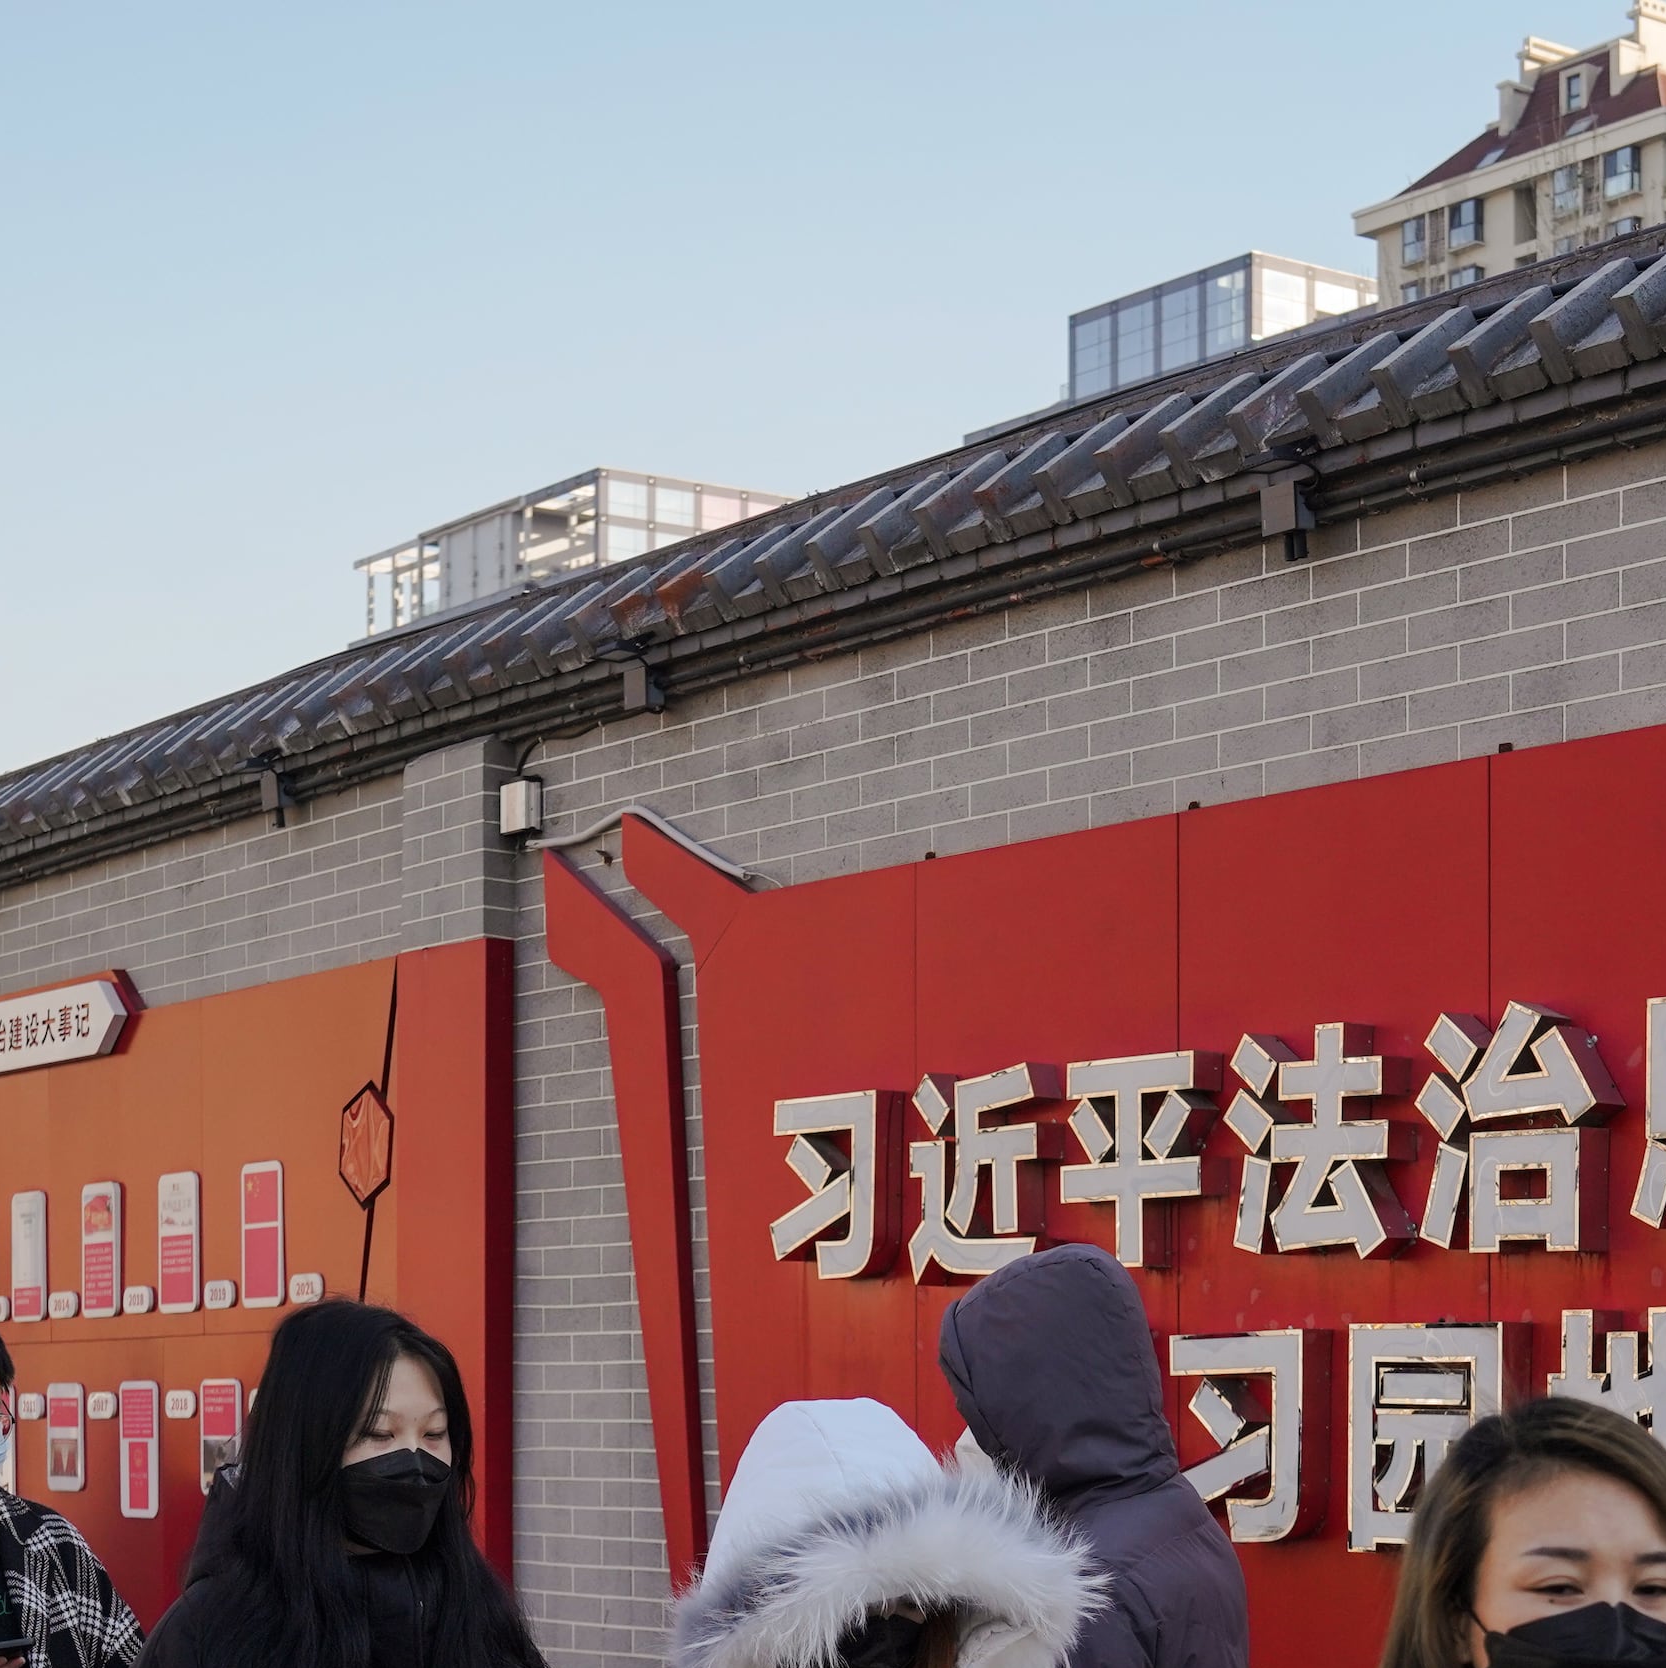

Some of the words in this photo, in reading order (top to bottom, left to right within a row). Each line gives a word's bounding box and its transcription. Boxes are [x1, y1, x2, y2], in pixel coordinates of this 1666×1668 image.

[209, 1288, 227, 1302] 2019
[295, 1281, 315, 1296] 2021
[53, 1299, 70, 1312] 2014
[128, 1293, 145, 1306] 2018
[92, 1399, 108, 1412] 2017
[171, 1398, 188, 1411] 2018
